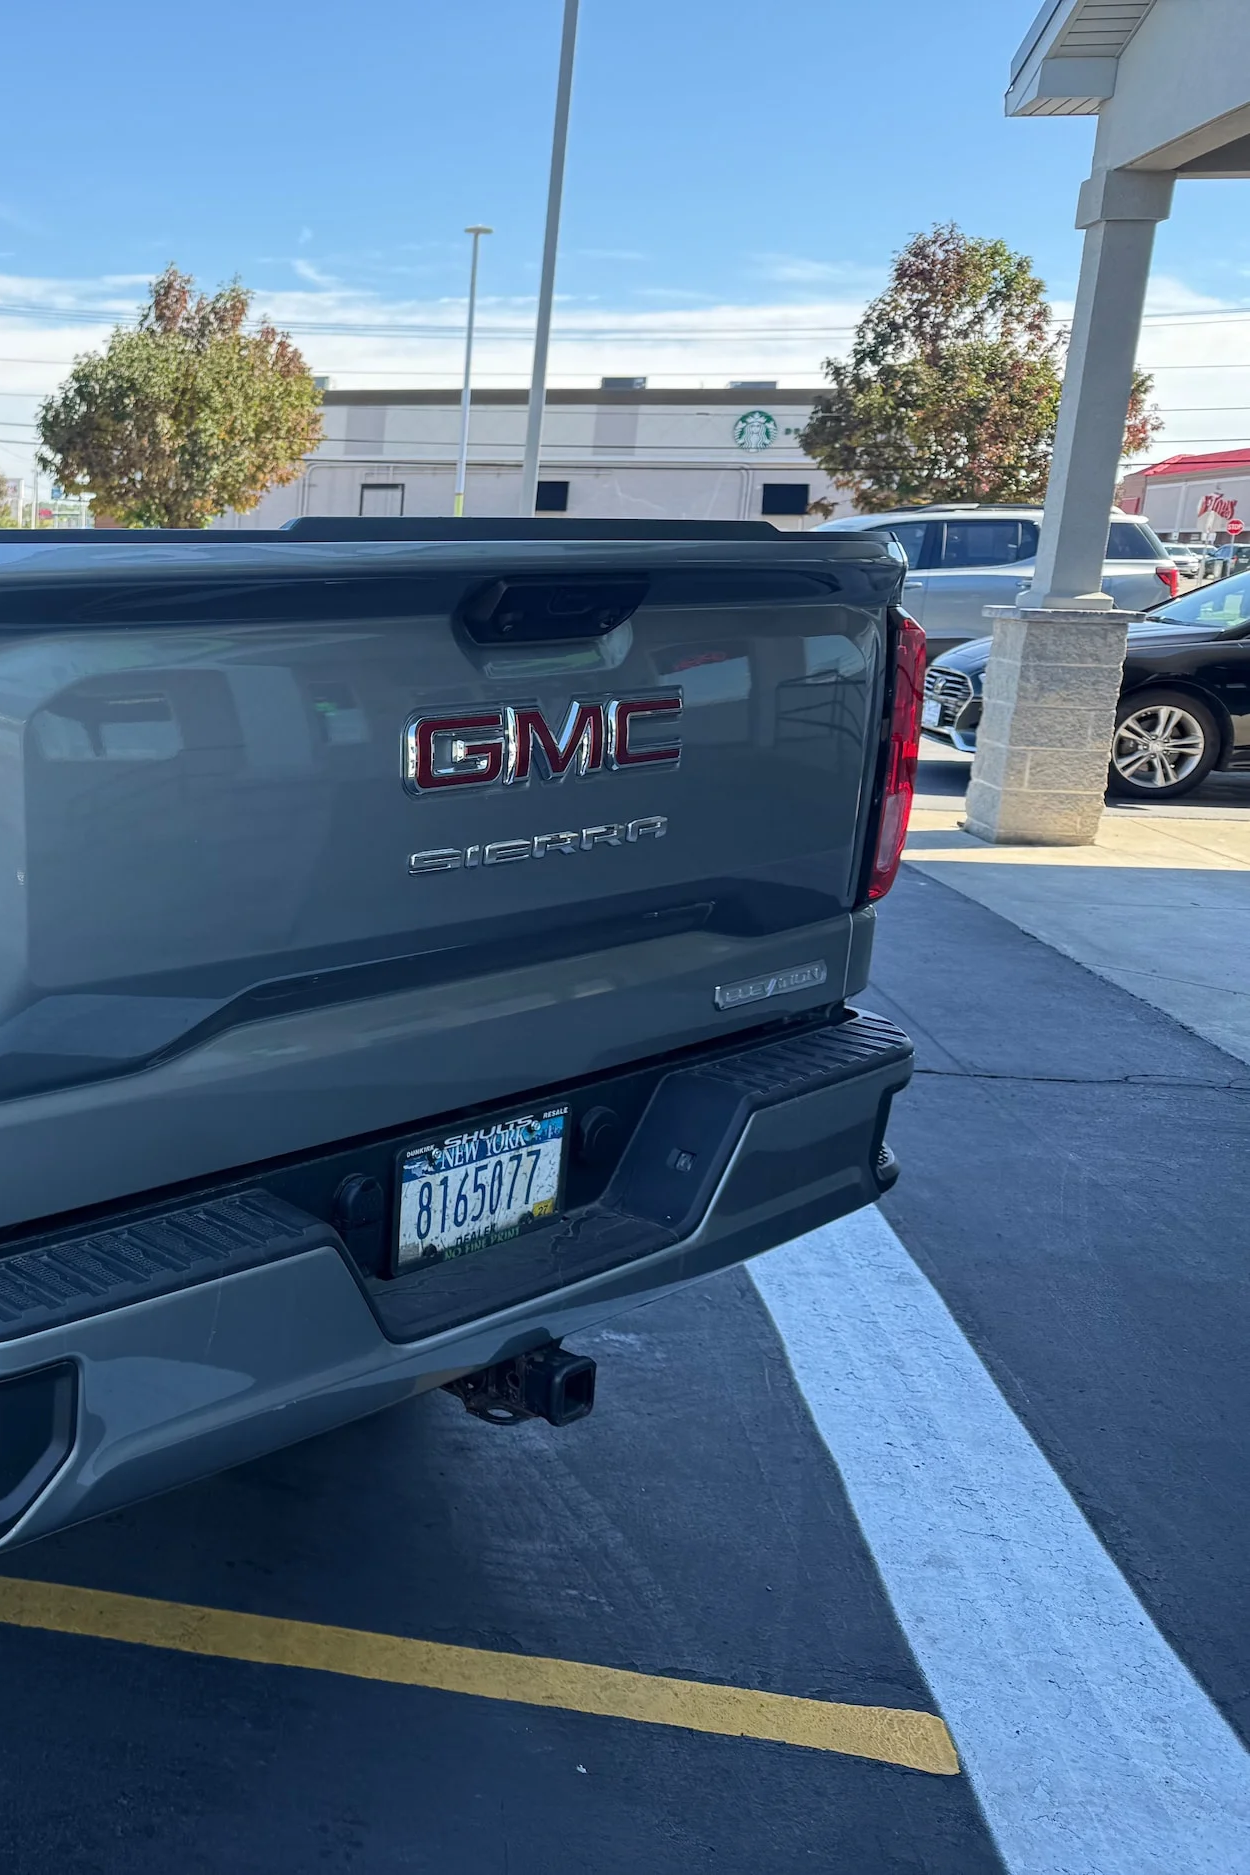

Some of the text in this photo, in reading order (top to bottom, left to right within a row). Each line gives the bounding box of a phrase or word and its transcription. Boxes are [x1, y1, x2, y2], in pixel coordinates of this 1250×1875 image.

[402, 689, 683, 796] GMC
[408, 815, 669, 876] SIERRA
[542, 1106, 569, 1119] RESALE
[440, 1127, 527, 1170] NEW YORK
[443, 1114, 534, 1149] SHULTS
[406, 1144, 435, 1158] DUNKIRK
[416, 1149, 542, 1240] 8165077
[537, 1204, 549, 1216] 27
[444, 1226, 521, 1261] NO FINE PRINT
[455, 1223, 496, 1248] DEALER
